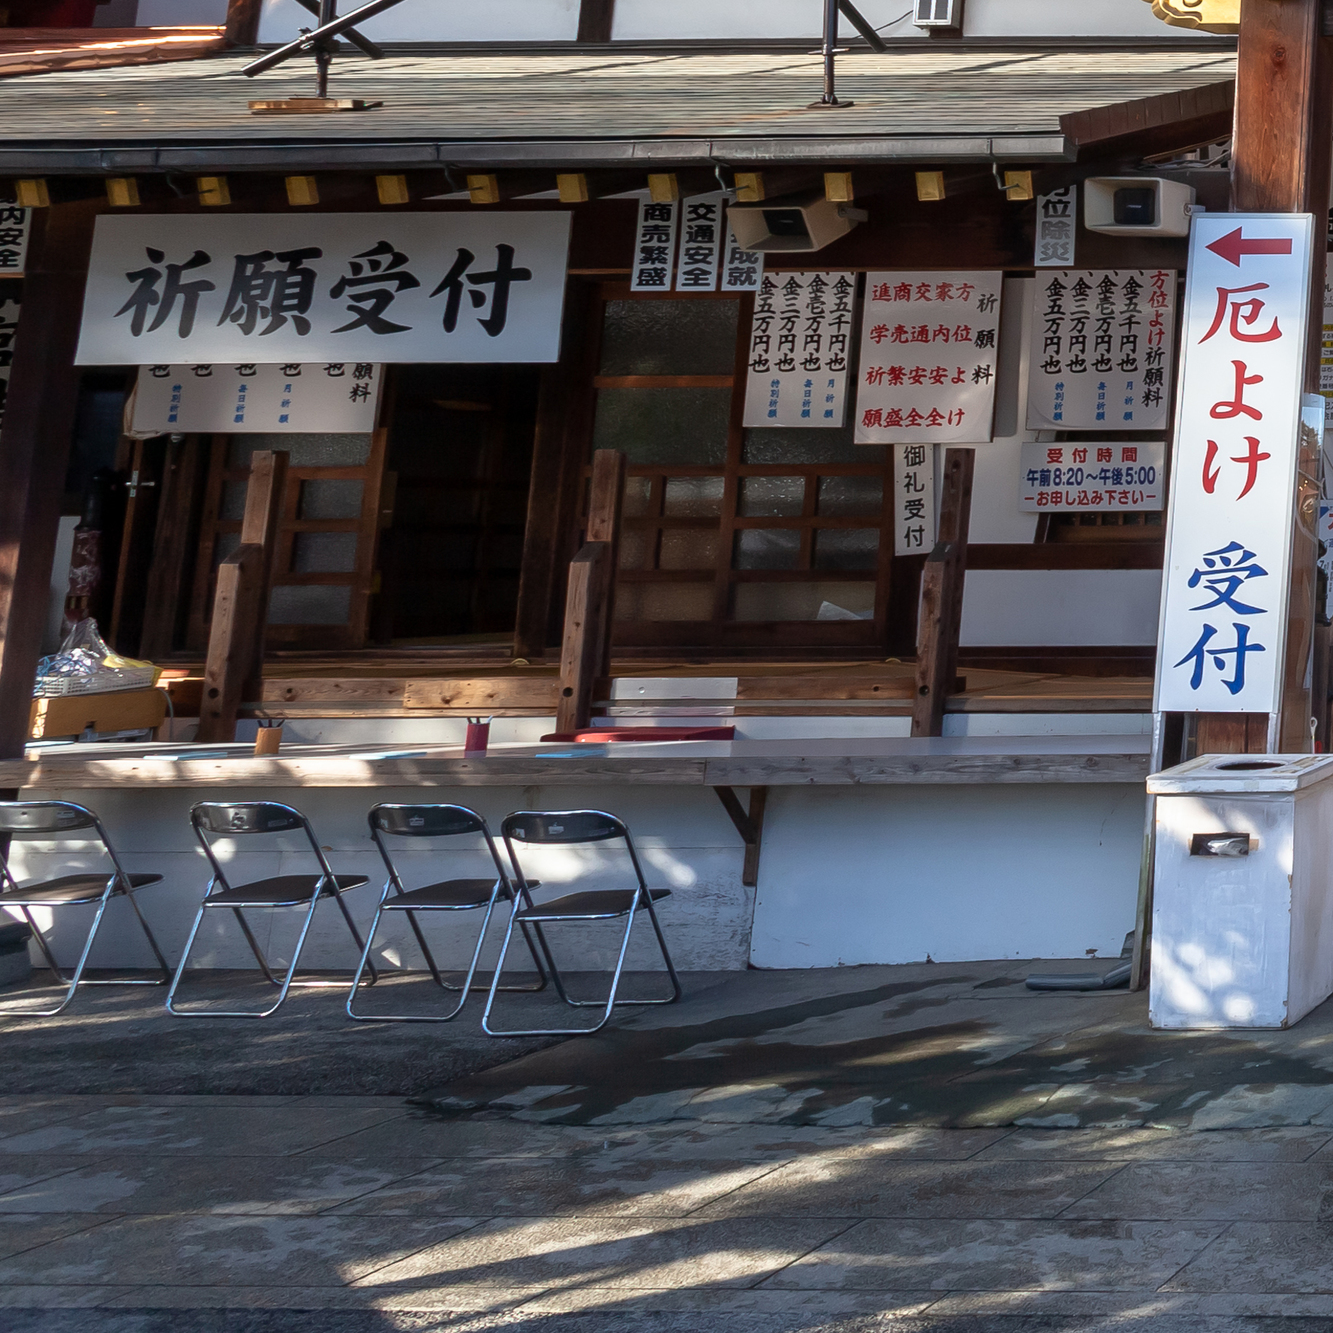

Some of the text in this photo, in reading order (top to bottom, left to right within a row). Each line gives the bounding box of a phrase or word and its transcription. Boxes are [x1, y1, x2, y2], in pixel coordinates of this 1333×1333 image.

[113, 240, 532, 338] 祈願受付
[636, 203, 672, 286] 商売繁盛
[681, 203, 716, 286] 交通安全
[862, 283, 891, 428] 進学祈願
[884, 283, 912, 428] 商売繁盛
[903, 283, 932, 428] 交通安全
[924, 283, 954, 428] 家内安全
[946, 283, 975, 427] 方位よけ
[971, 293, 998, 385] 祈願料
[1142, 271, 1169, 408] 方位よけ祈願料
[903, 445, 925, 548] 御礼受付
[1047, 447, 1138, 464] 受付時間
[1173, 282, 1283, 696] 厄よけ 受付
